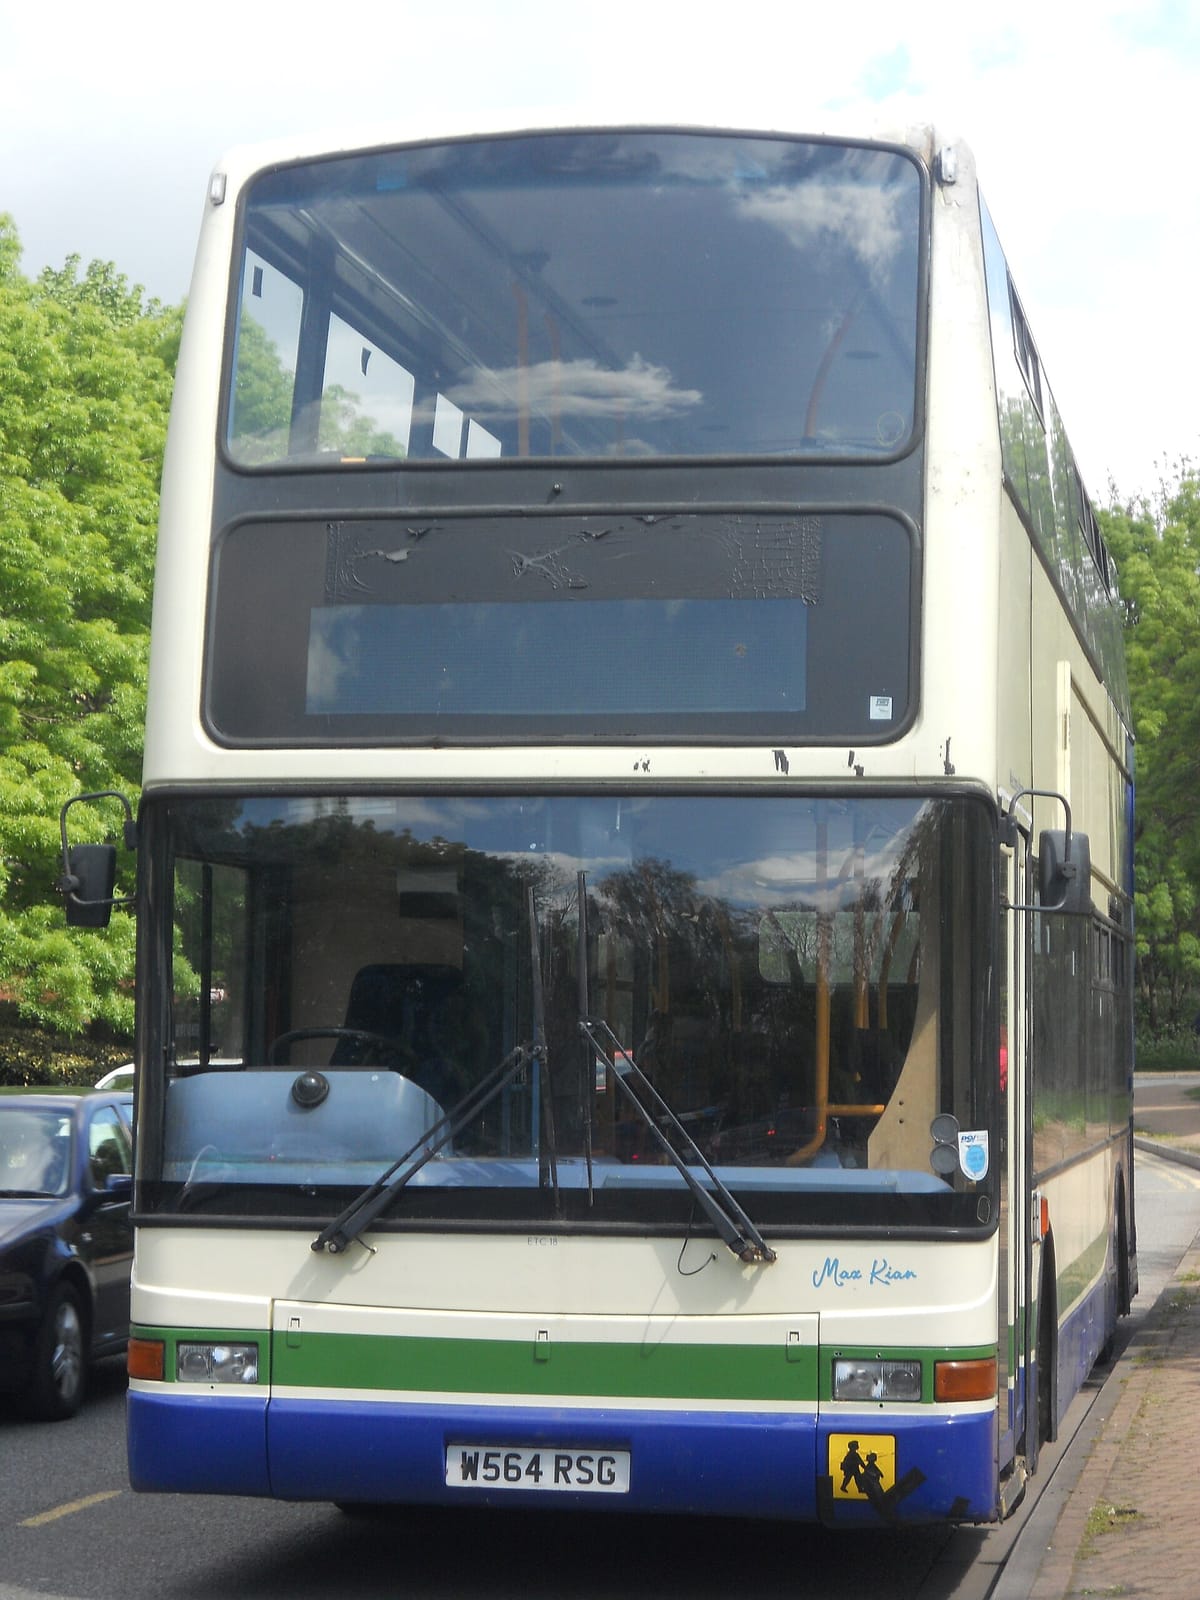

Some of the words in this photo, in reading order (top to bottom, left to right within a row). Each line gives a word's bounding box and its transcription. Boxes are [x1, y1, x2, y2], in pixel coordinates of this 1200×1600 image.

[812, 1257, 862, 1288] Max
[869, 1258, 917, 1285] Kian
[461, 1451, 543, 1483] W564
[553, 1455, 616, 1485] RSG
